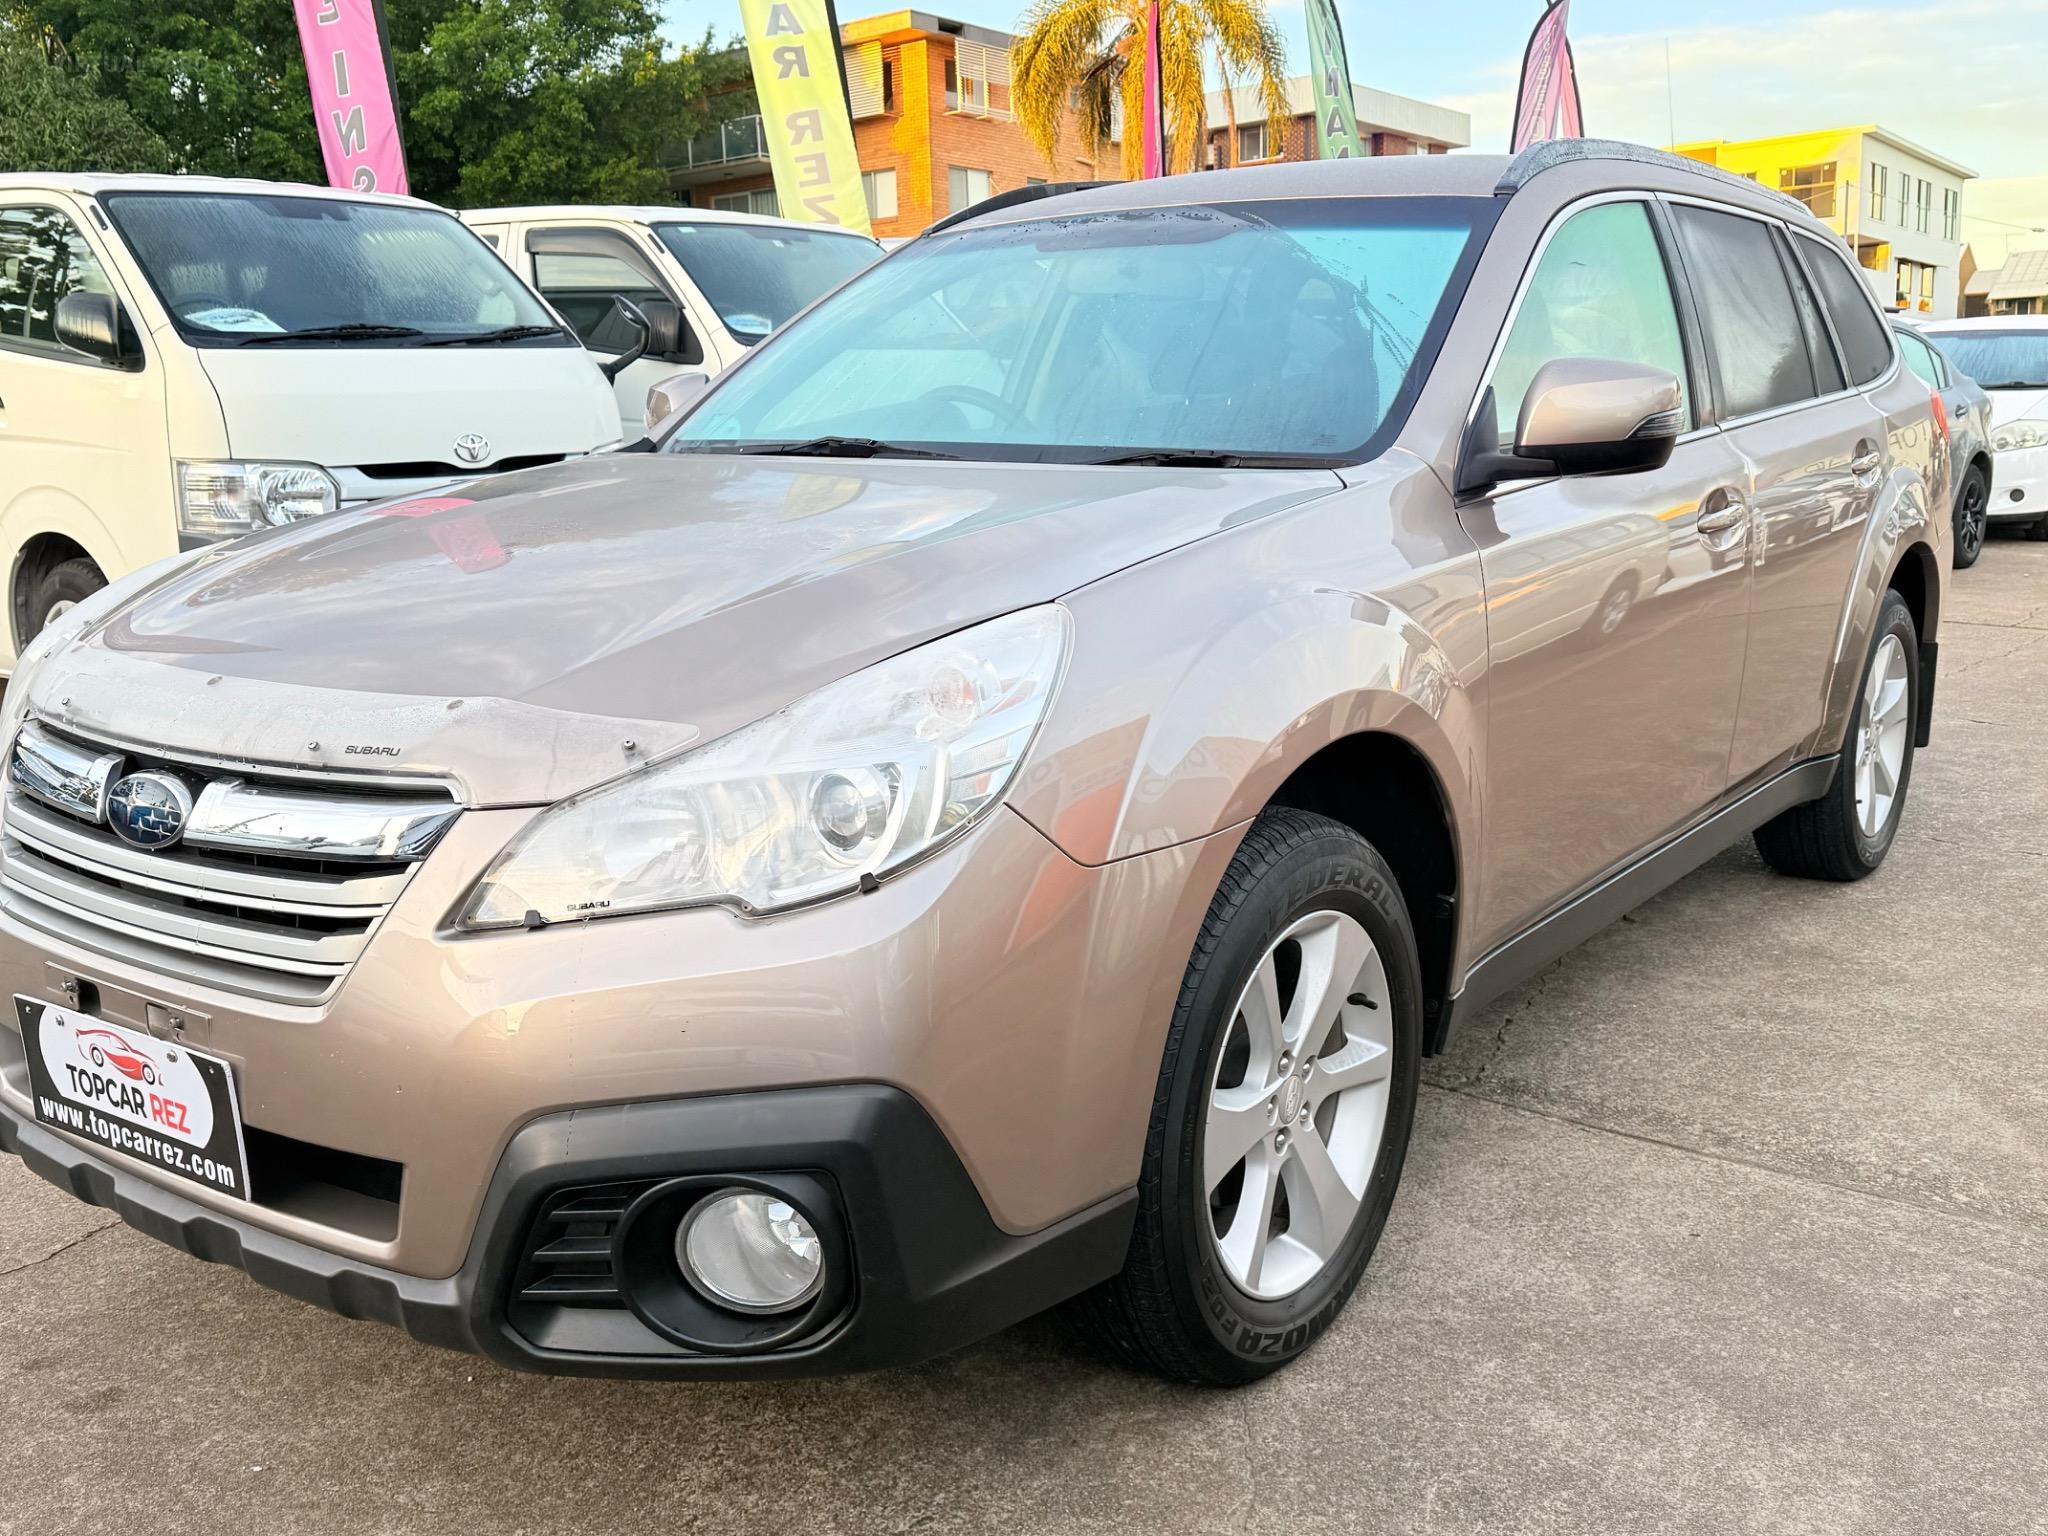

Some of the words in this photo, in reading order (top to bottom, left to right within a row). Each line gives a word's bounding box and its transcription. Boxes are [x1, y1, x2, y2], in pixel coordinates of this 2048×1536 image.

[344, 745, 401, 757] SUBARU
[566, 900, 610, 912] SUBARU
[65, 1063, 148, 1119] TOPCAR
[149, 1093, 191, 1135] REZ
[39, 1095, 236, 1189] www.topcarrez.com
